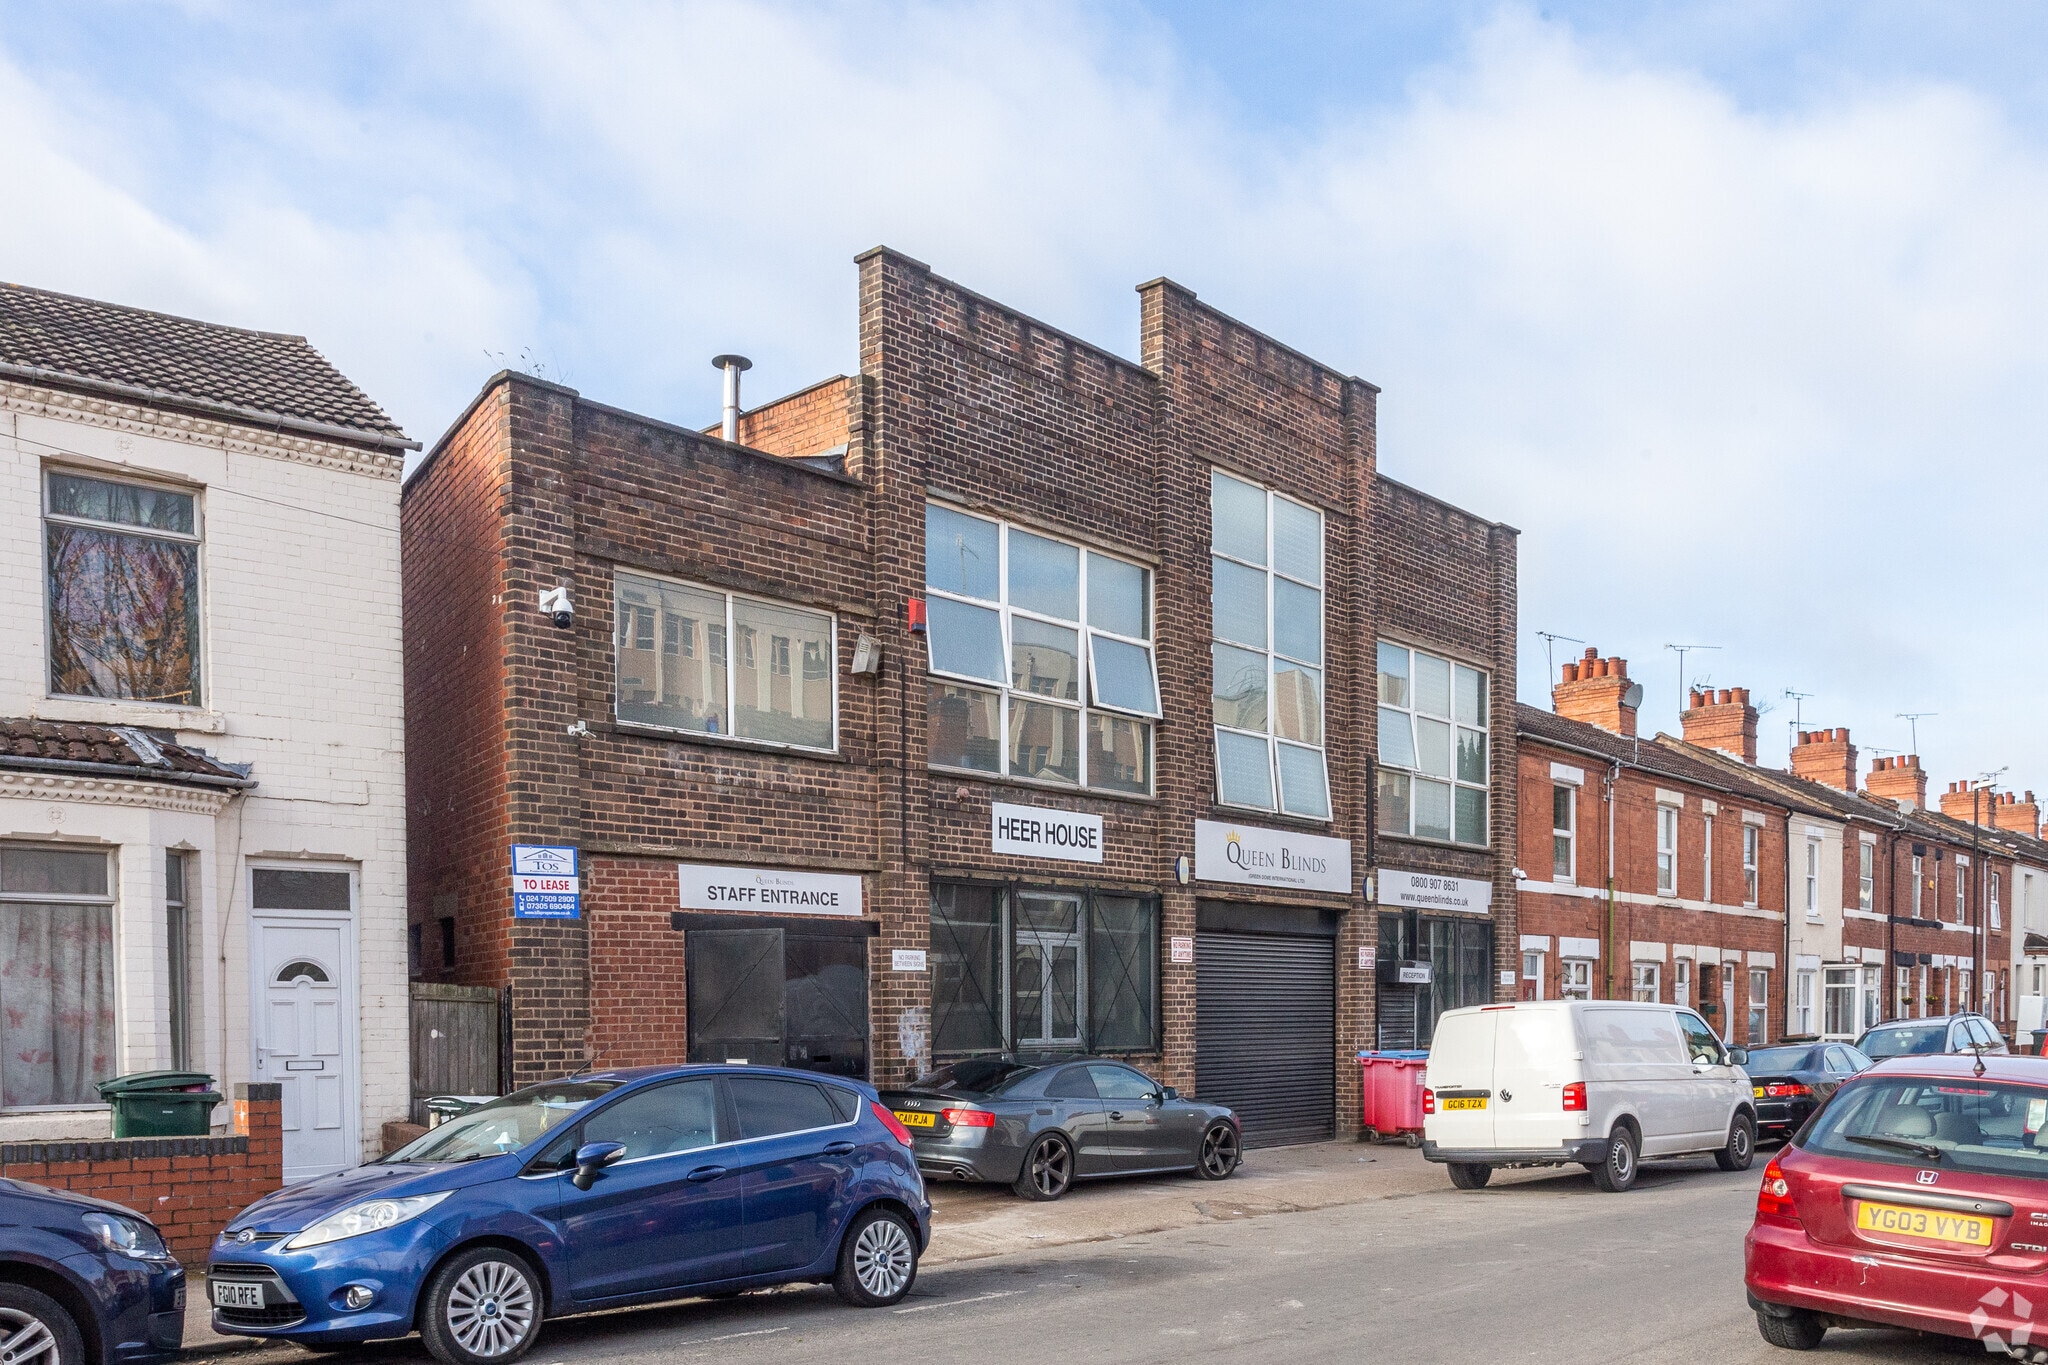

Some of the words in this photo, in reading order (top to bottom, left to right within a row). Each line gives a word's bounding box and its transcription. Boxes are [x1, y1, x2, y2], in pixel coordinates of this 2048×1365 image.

[998, 816, 1041, 843] HEER
[1045, 822, 1097, 849] HOUSE
[1226, 841, 1275, 870] QUEEN
[1281, 847, 1327, 874] BLINDS
[523, 879, 537, 890] TO
[541, 880, 570, 890] LEASE
[1411, 876, 1428, 888] 0800
[1429, 878, 1442, 890] 907
[1443, 880, 1459, 892] 8631
[707, 885, 756, 902] STAFF
[761, 888, 839, 906] ENTRANCE
[1400, 892, 1469, 906] www.queenblinds.co.uk
[1402, 971, 1426, 979] RECEPTION
[1448, 1100, 1465, 1109] GC16
[1467, 1099, 1483, 1108] TZX
[913, 1115, 928, 1125] RJA
[1869, 1206, 1928, 1233] YG03
[1936, 1215, 1981, 1240] VYB
[217, 1285, 236, 1304] FG10
[238, 1286, 258, 1305] RFE
